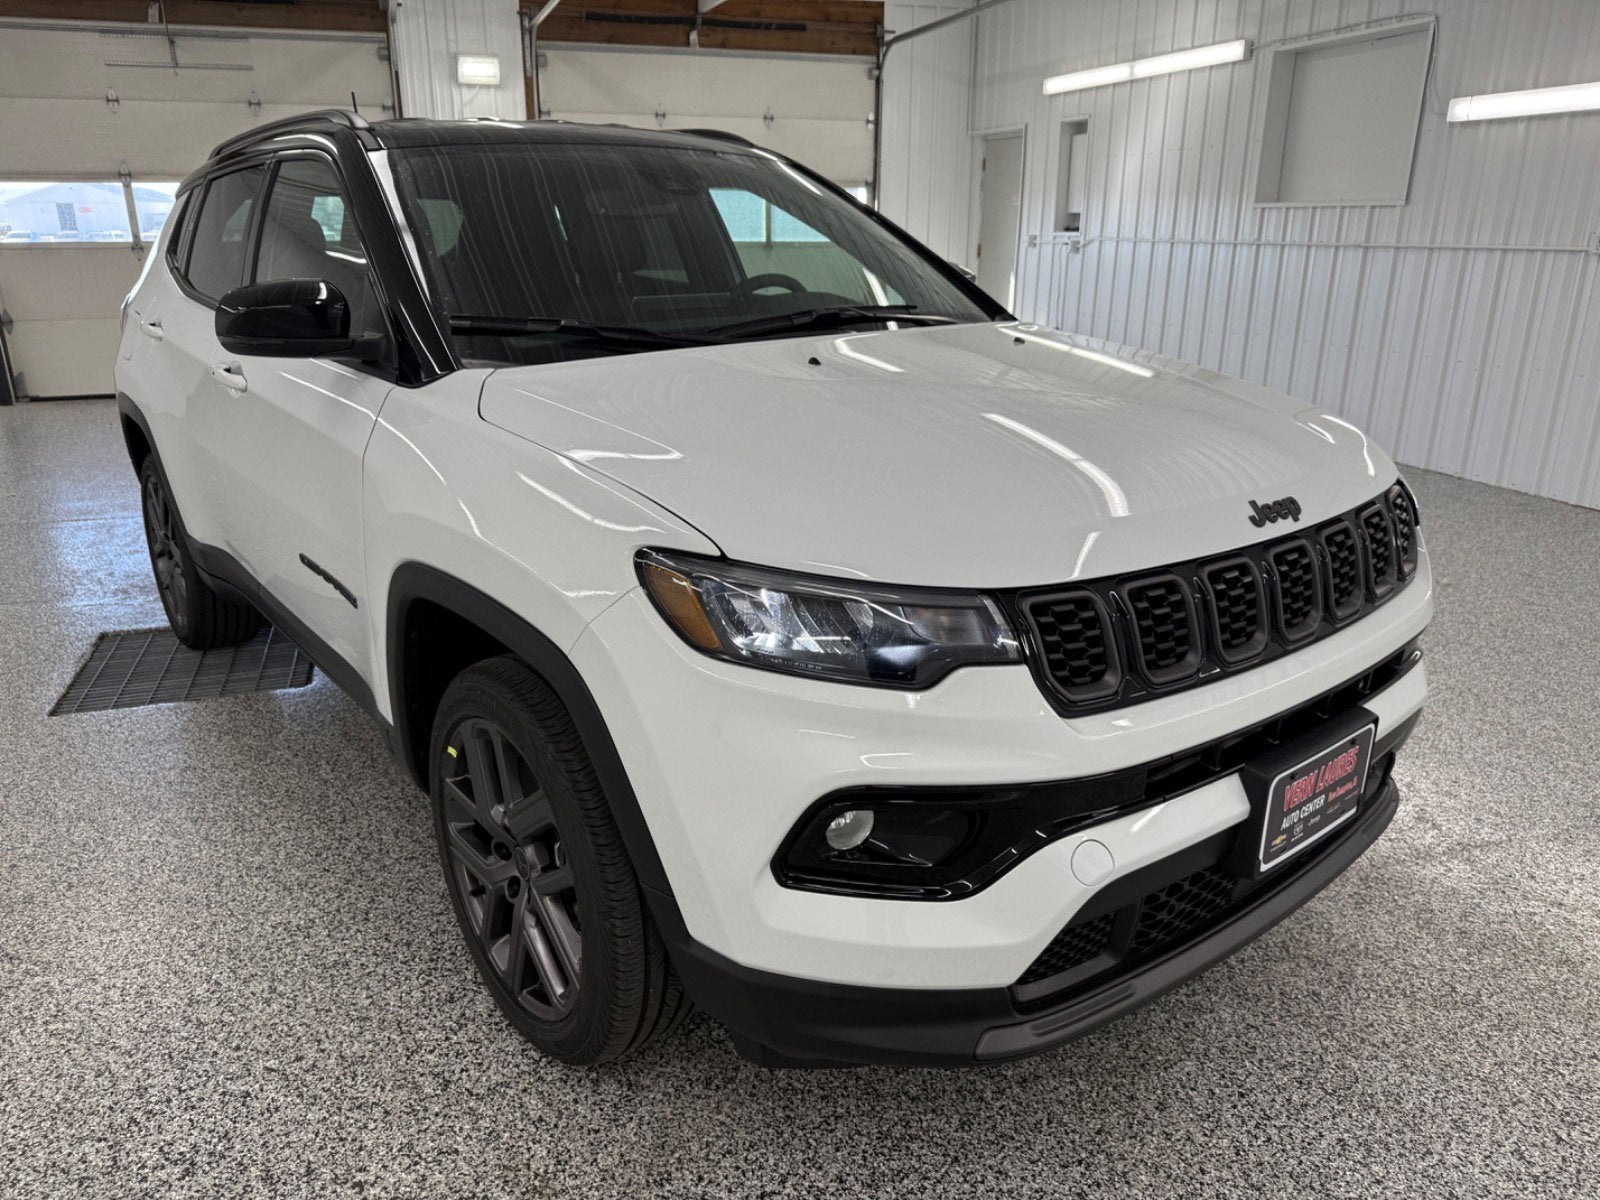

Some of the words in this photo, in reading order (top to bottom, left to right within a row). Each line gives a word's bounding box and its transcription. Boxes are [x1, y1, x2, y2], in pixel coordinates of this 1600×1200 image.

[1248, 496, 1302, 528] Jeep
[1283, 770, 1318, 811] VERN
[1280, 810, 1300, 831] AUTO
[1300, 795, 1325, 821] CENTER
